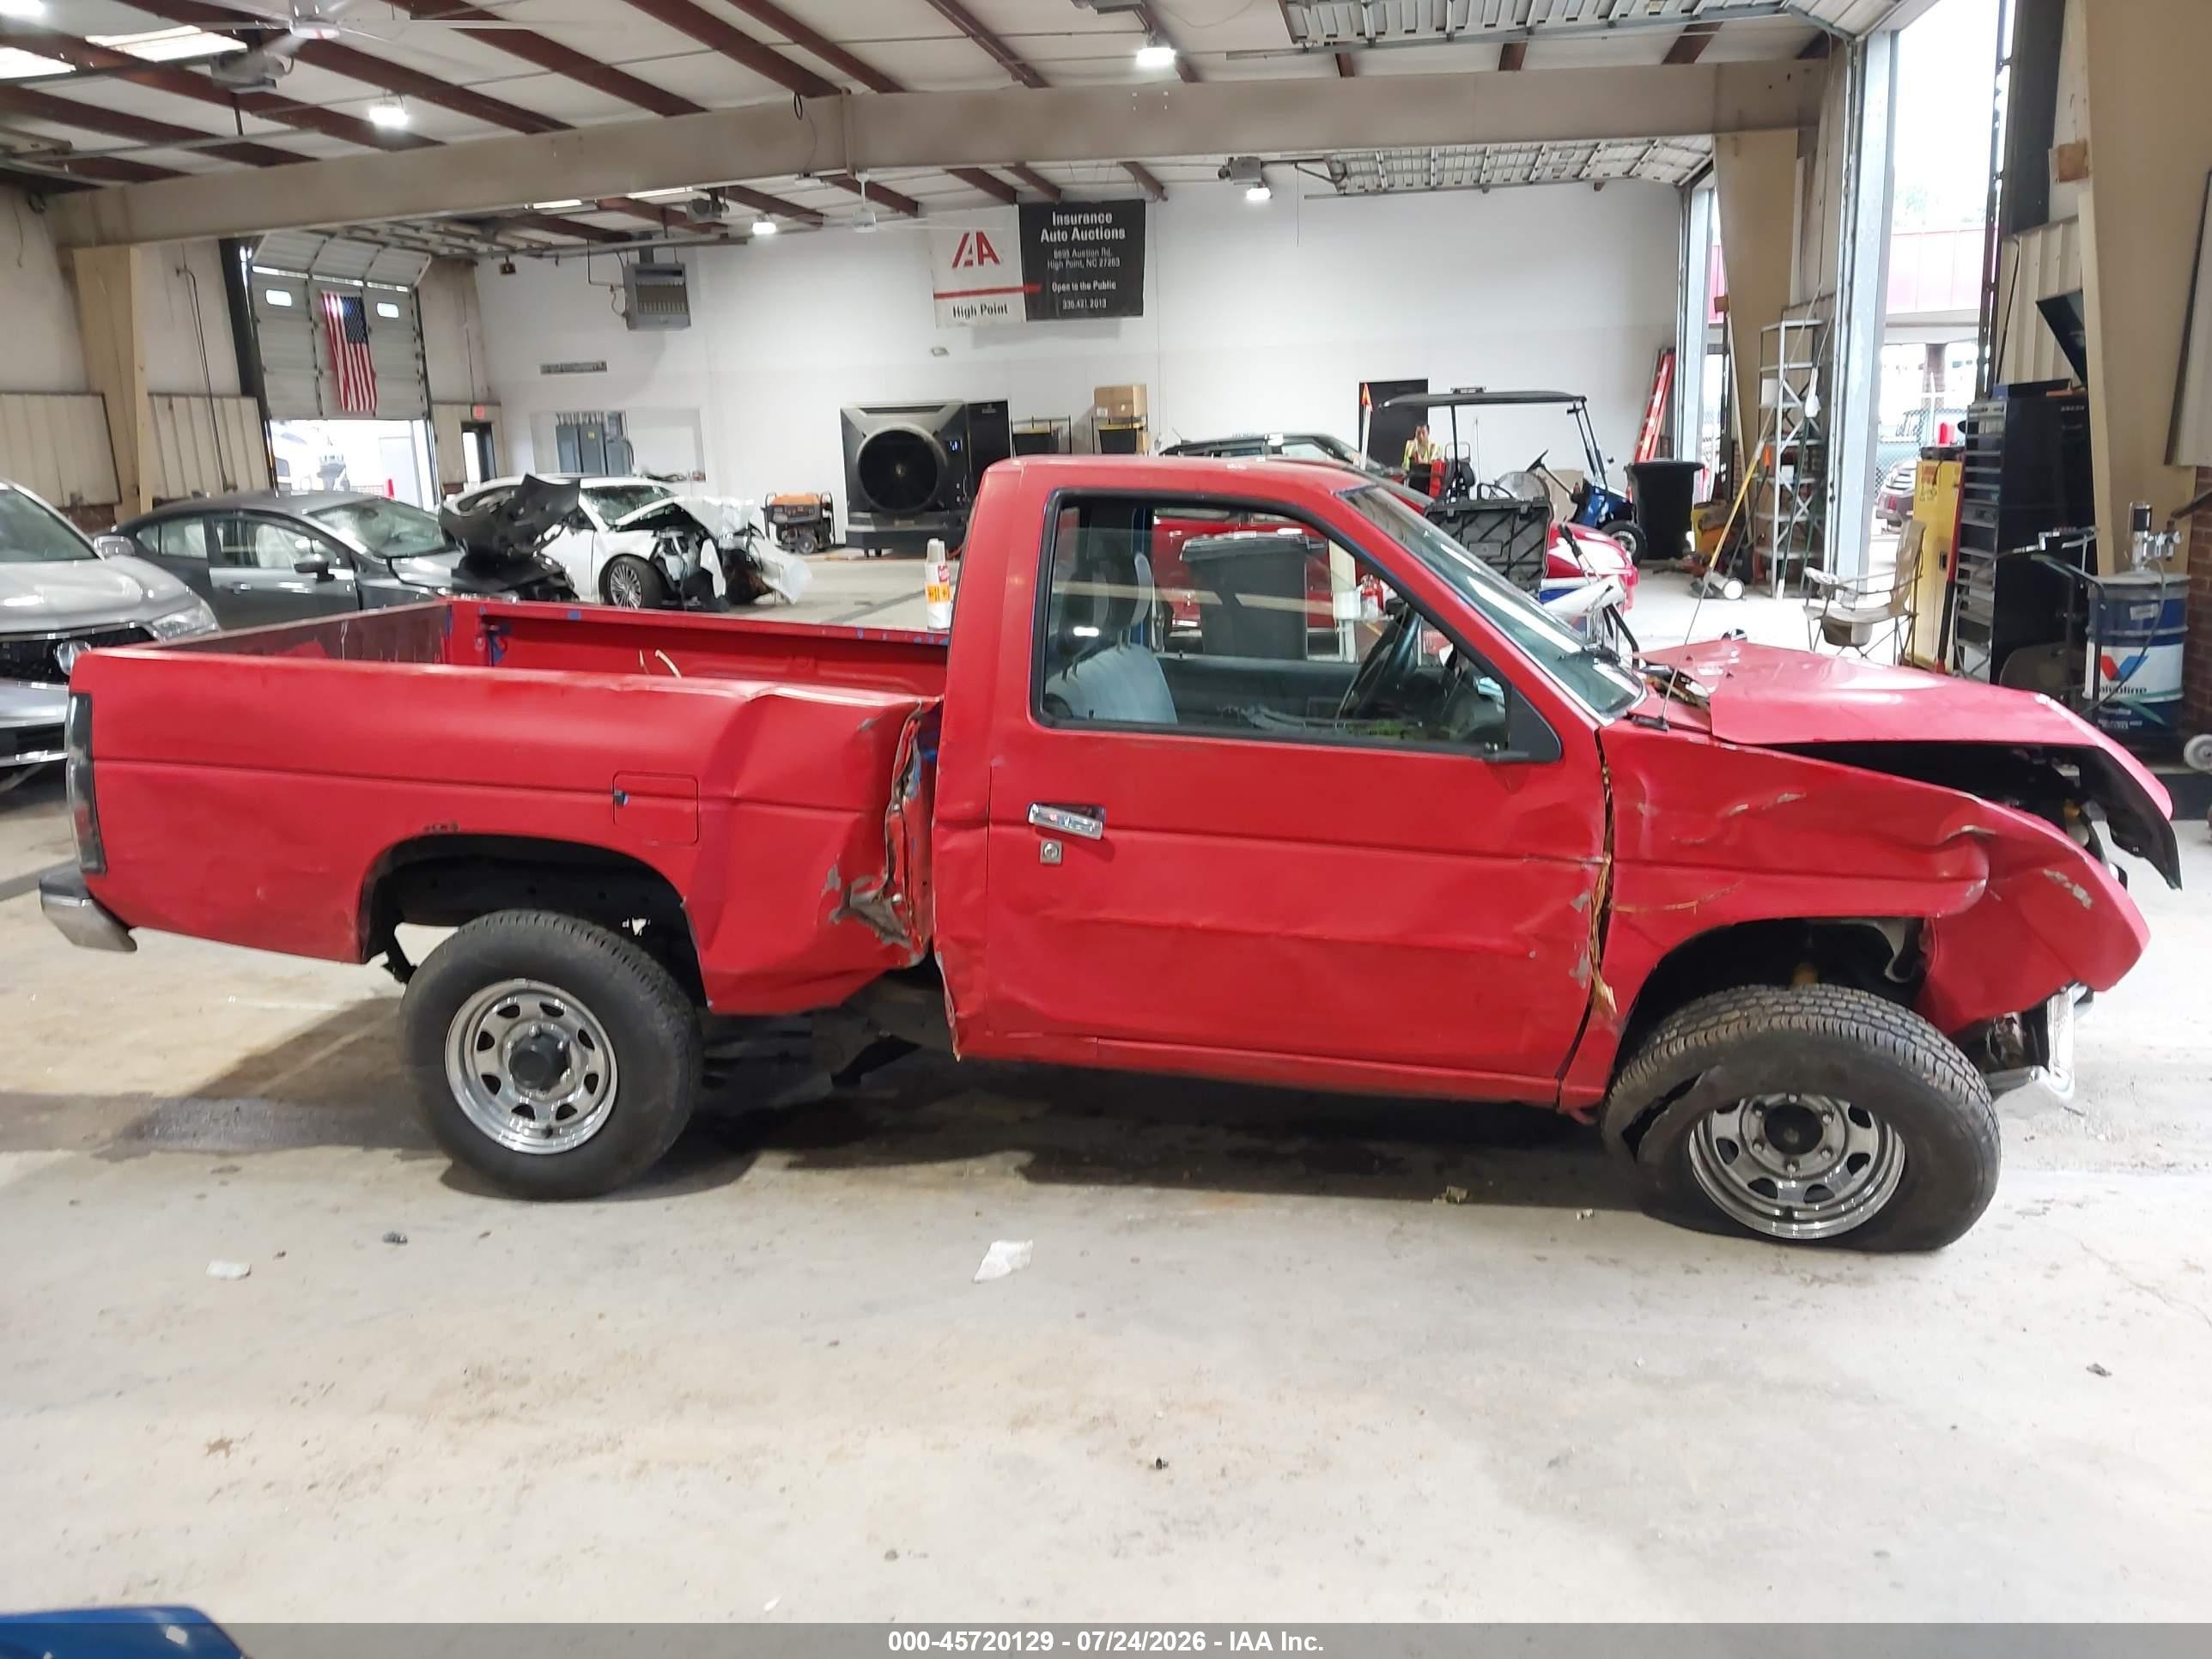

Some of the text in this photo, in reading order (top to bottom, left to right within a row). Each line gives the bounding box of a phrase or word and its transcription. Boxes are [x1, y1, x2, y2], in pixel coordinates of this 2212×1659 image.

[1052, 211, 1113, 226] Insurance
[1040, 226, 1126, 243] Auto Auctions
[1072, 247, 1099, 258] Auction
[1048, 258, 1064, 271] High
[1086, 258, 1097, 268] NC
[1052, 279, 1116, 293] Open to the Public
[952, 302, 1008, 319] High Point
